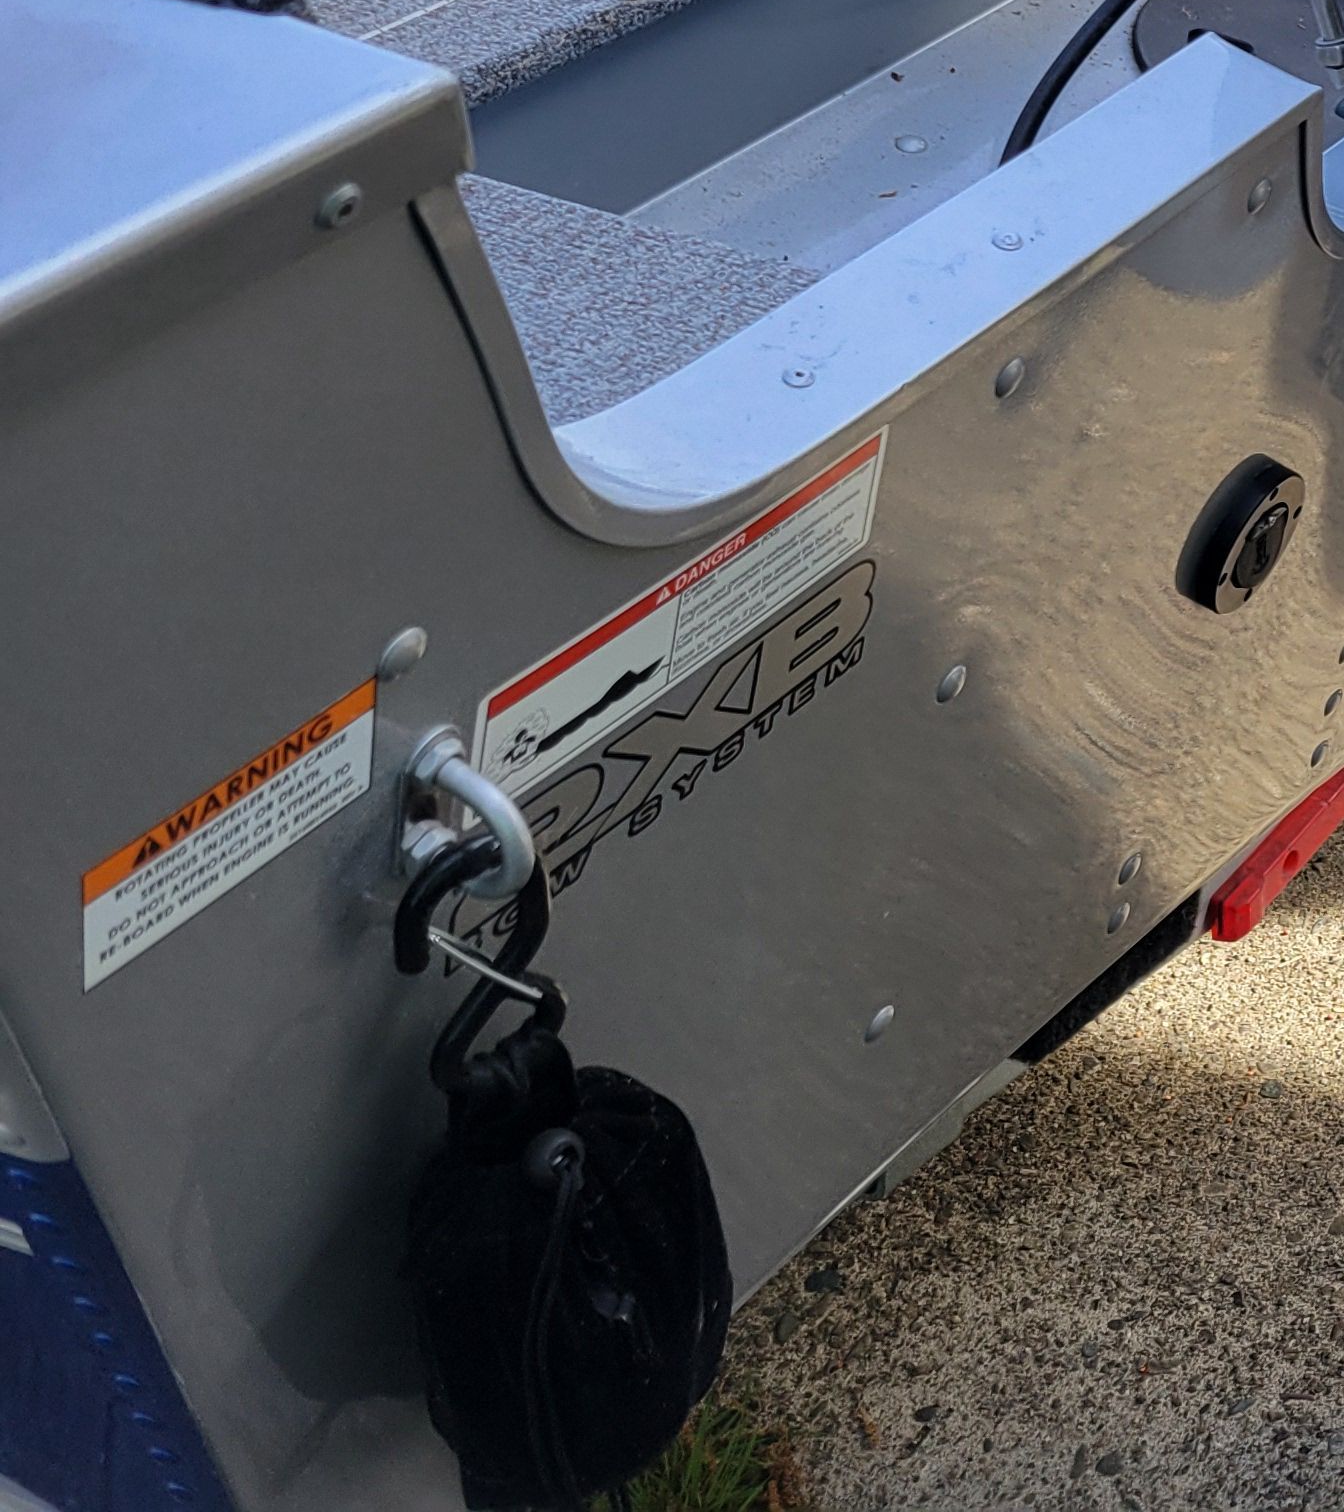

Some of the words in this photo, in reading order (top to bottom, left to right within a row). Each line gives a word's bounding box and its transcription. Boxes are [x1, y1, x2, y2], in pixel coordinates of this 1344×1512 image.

[674, 532, 747, 592] DANGER
[164, 714, 333, 843] WARNING
[627, 636, 866, 838] SYSTEM
[108, 917, 132, 940] DO
[136, 893, 166, 920] NOT
[171, 837, 249, 897] APPROACH
[253, 819, 272, 838] OR
[277, 777, 332, 820] ATTEMPT
[334, 762, 352, 784] TO
[114, 846, 188, 902] ROTATING
[192, 788, 265, 848] PROPELLER
[268, 767, 300, 793] MAY
[304, 733, 348, 768] CAUSE
[140, 854, 198, 901] SERIOUS
[202, 817, 251, 858] INJURY
[255, 803, 275, 822] OR
[100, 904, 175, 963] RE-BOARD
[178, 872, 220, 907] WHEN
[223, 833, 275, 875] ENGINE
[277, 824, 290, 840] IS
